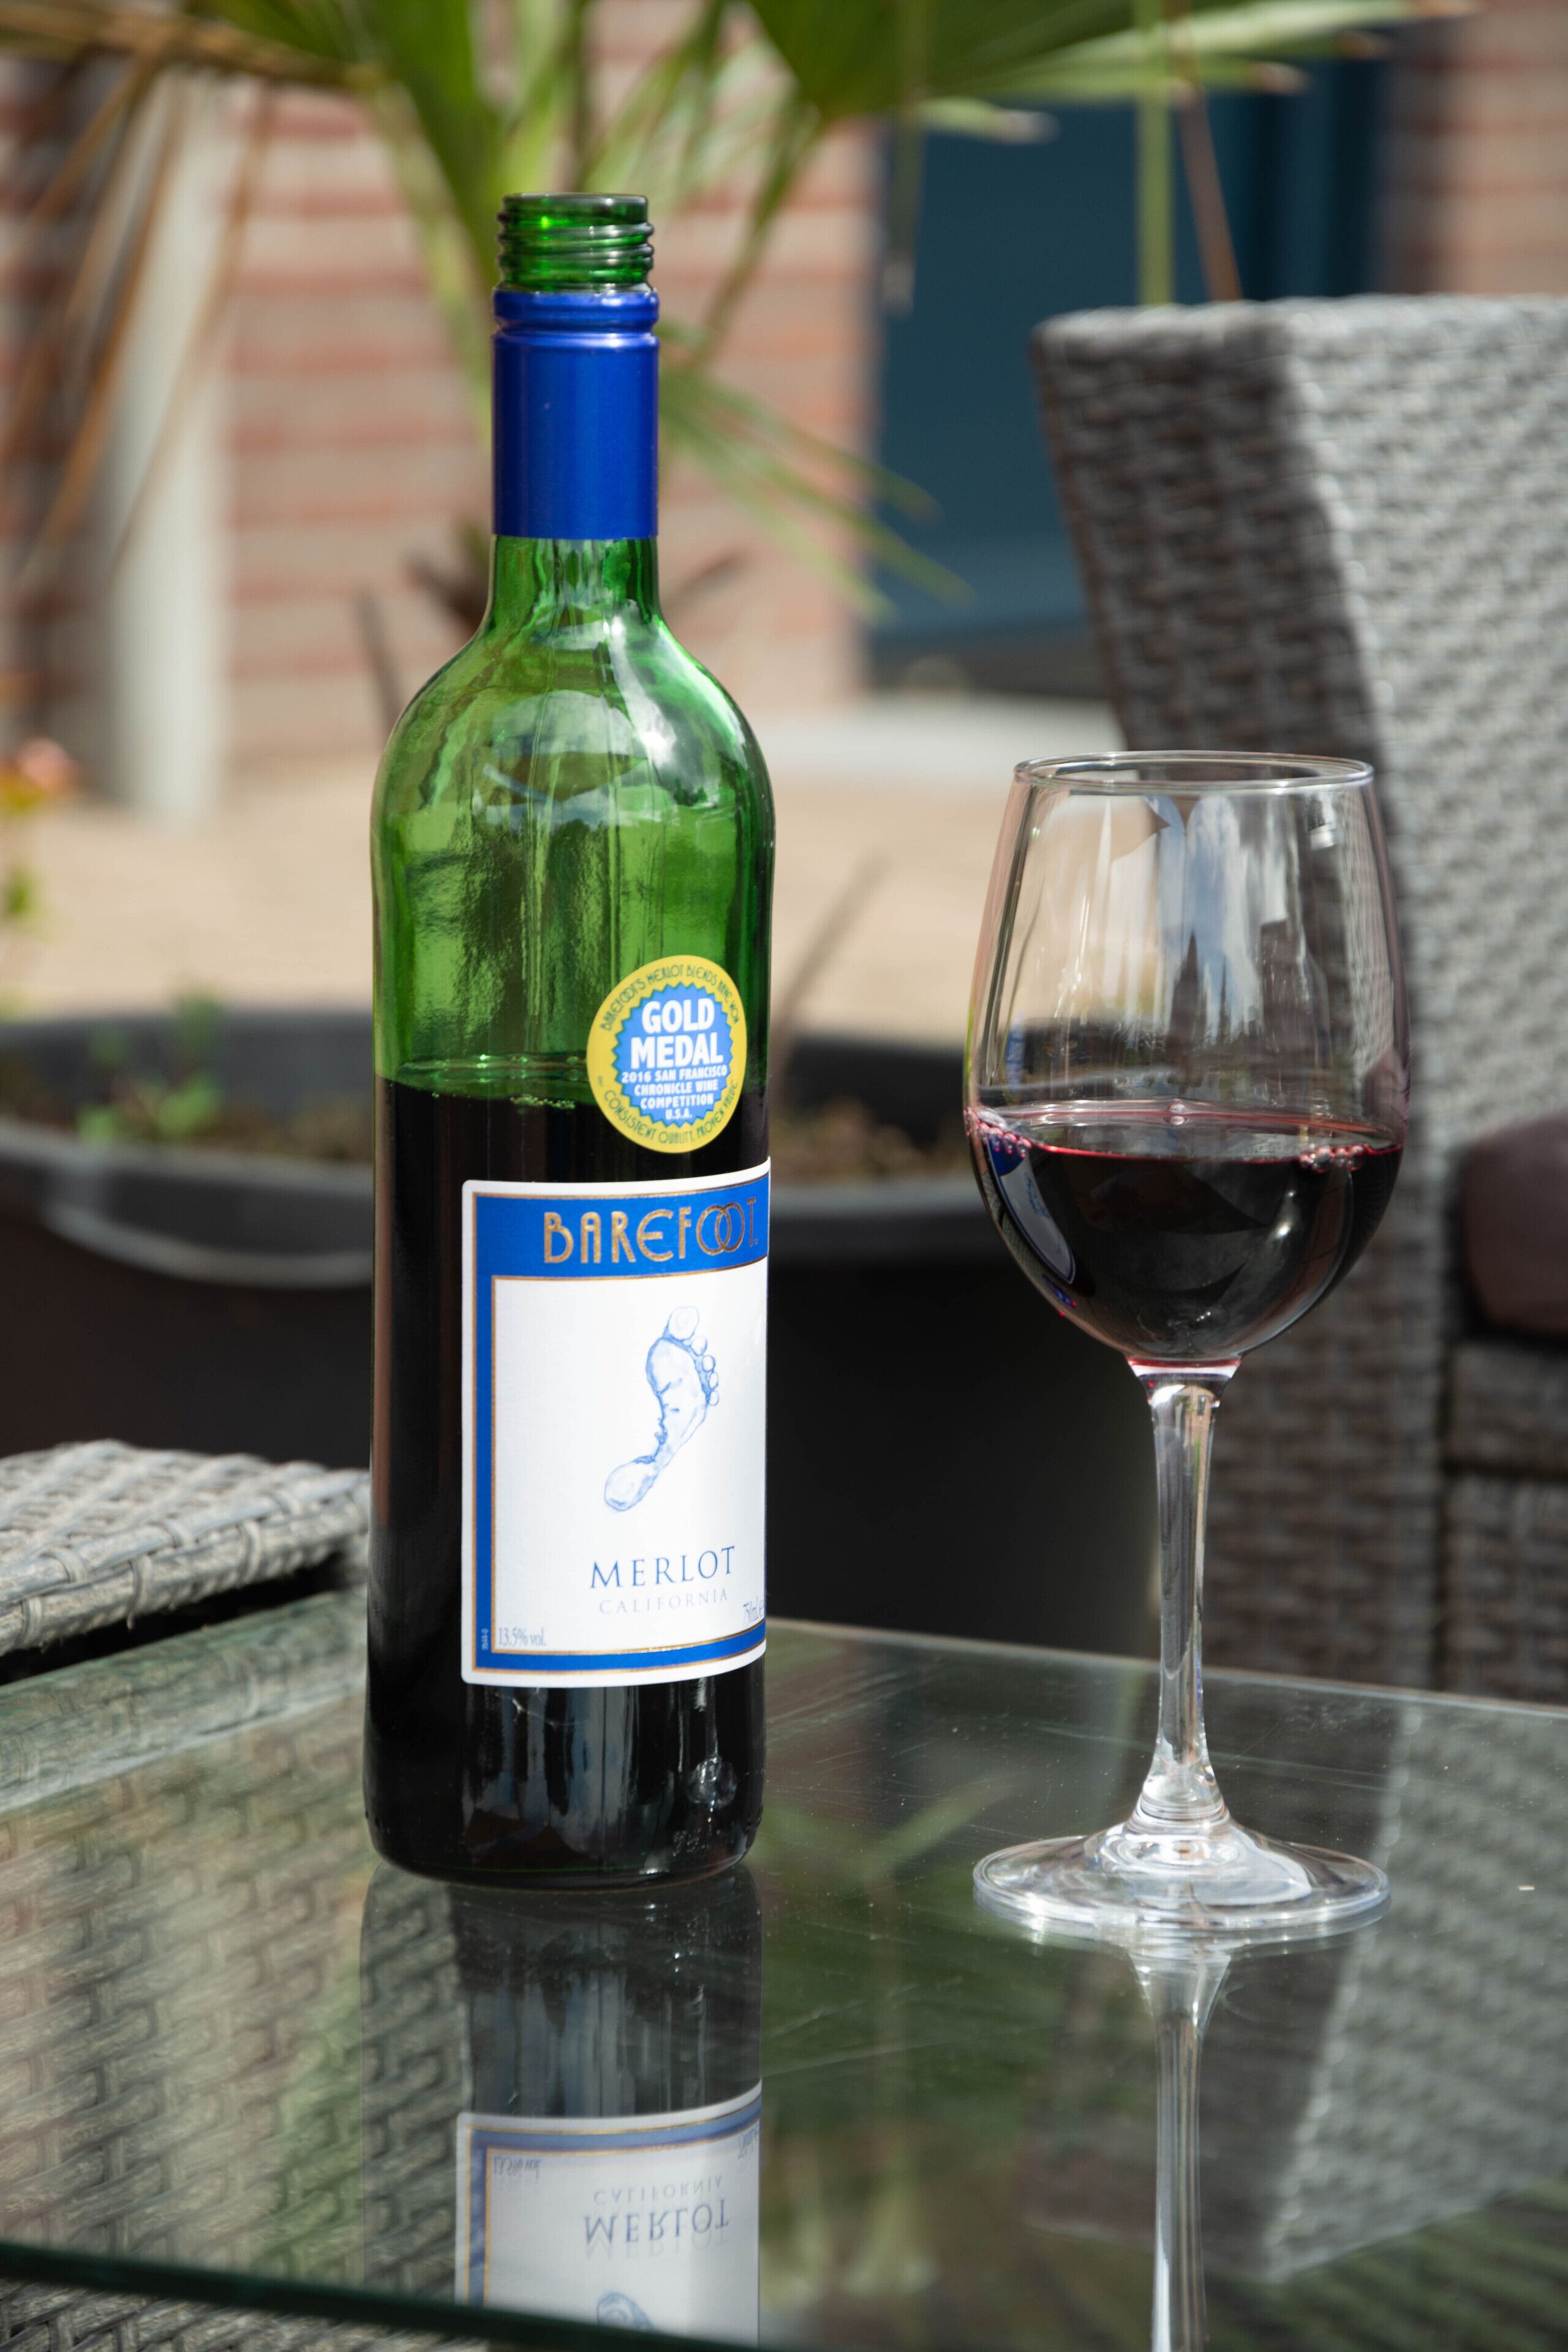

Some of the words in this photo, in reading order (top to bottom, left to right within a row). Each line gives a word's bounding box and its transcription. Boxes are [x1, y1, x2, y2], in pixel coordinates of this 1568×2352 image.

[646, 964, 684, 985] MERLOT
[641, 998, 715, 1034] GOLD
[630, 1032, 724, 1069] MEDAL
[621, 1071, 651, 1084] 2016
[654, 1069, 676, 1082] SAN
[679, 1064, 728, 1080] FRANCISCO
[634, 1081, 692, 1096] CHRONICLE
[695, 1079, 718, 1093] WINE
[640, 1093, 714, 1109] COMPETITION
[604, 1090, 657, 1140] CONSISTENT
[665, 1107, 693, 1120] U.S.A.
[543, 1197, 756, 1264] BAREFOOT
[589, 1545, 736, 1589] MERLOT
[598, 1588, 728, 1615] CALIFORNIA
[499, 1627, 529, 1648] 13.5%
[530, 1627, 547, 1648] vol.
